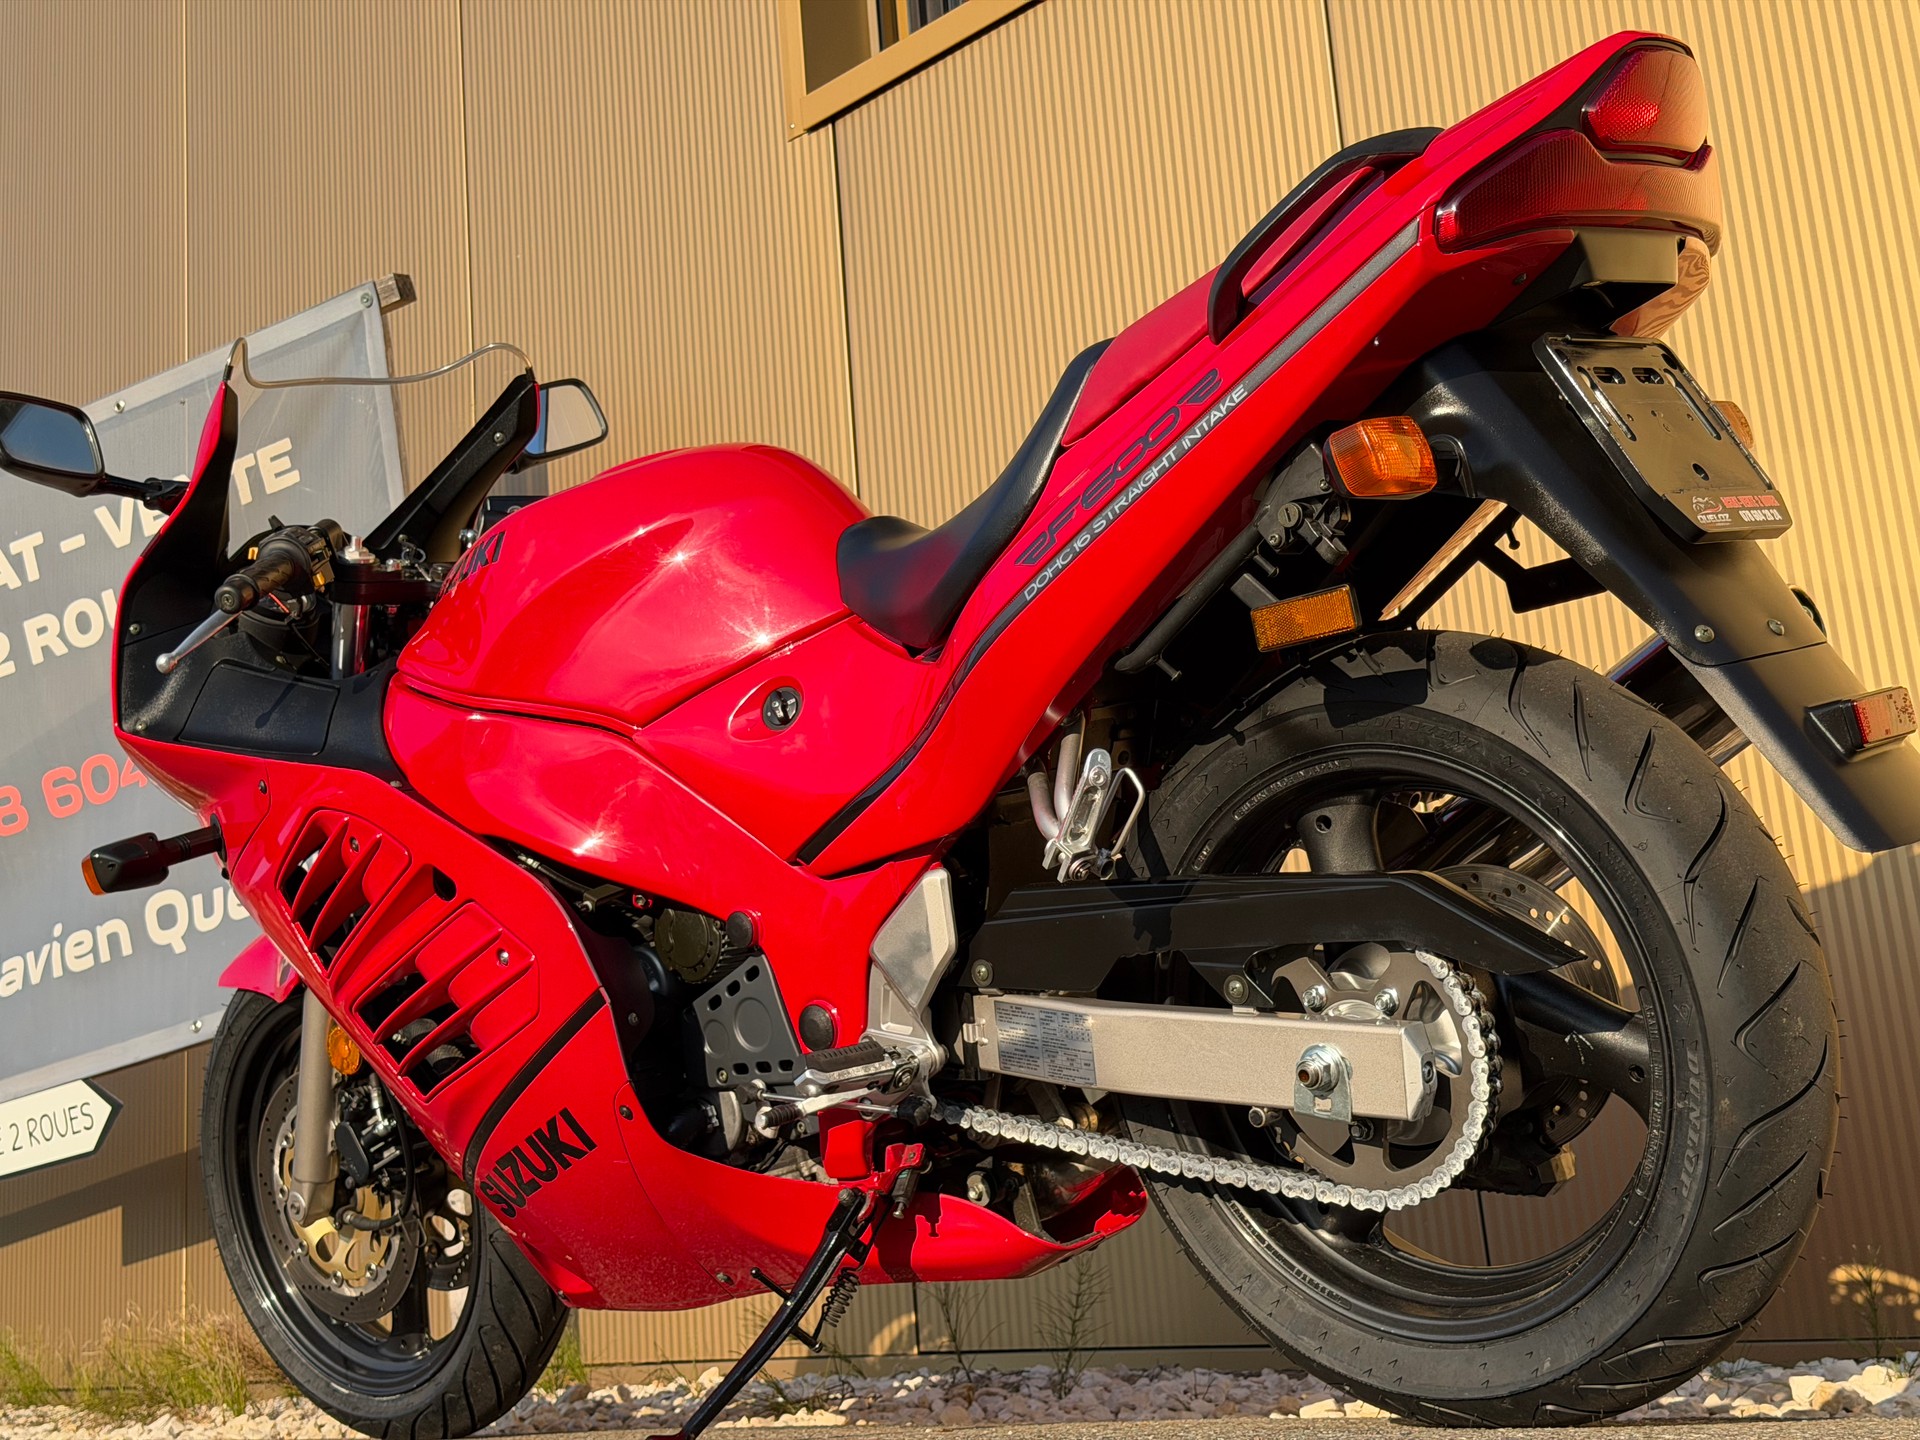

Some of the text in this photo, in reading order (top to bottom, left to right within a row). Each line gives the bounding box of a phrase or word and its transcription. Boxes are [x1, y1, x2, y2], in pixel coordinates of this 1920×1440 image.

[93, 436, 301, 549] VETE
[1092, 445, 1178, 534] STRAIGHT
[1182, 384, 1248, 450] INTAKE
[0, 785, 29, 837] 8
[0, 922, 133, 998] avien
[9, 1122, 23, 1151] 2
[26, 1101, 94, 1148] ROUES
[479, 1107, 598, 1218] SUZUKI
[1680, 1047, 1702, 1199] DUNLOP
